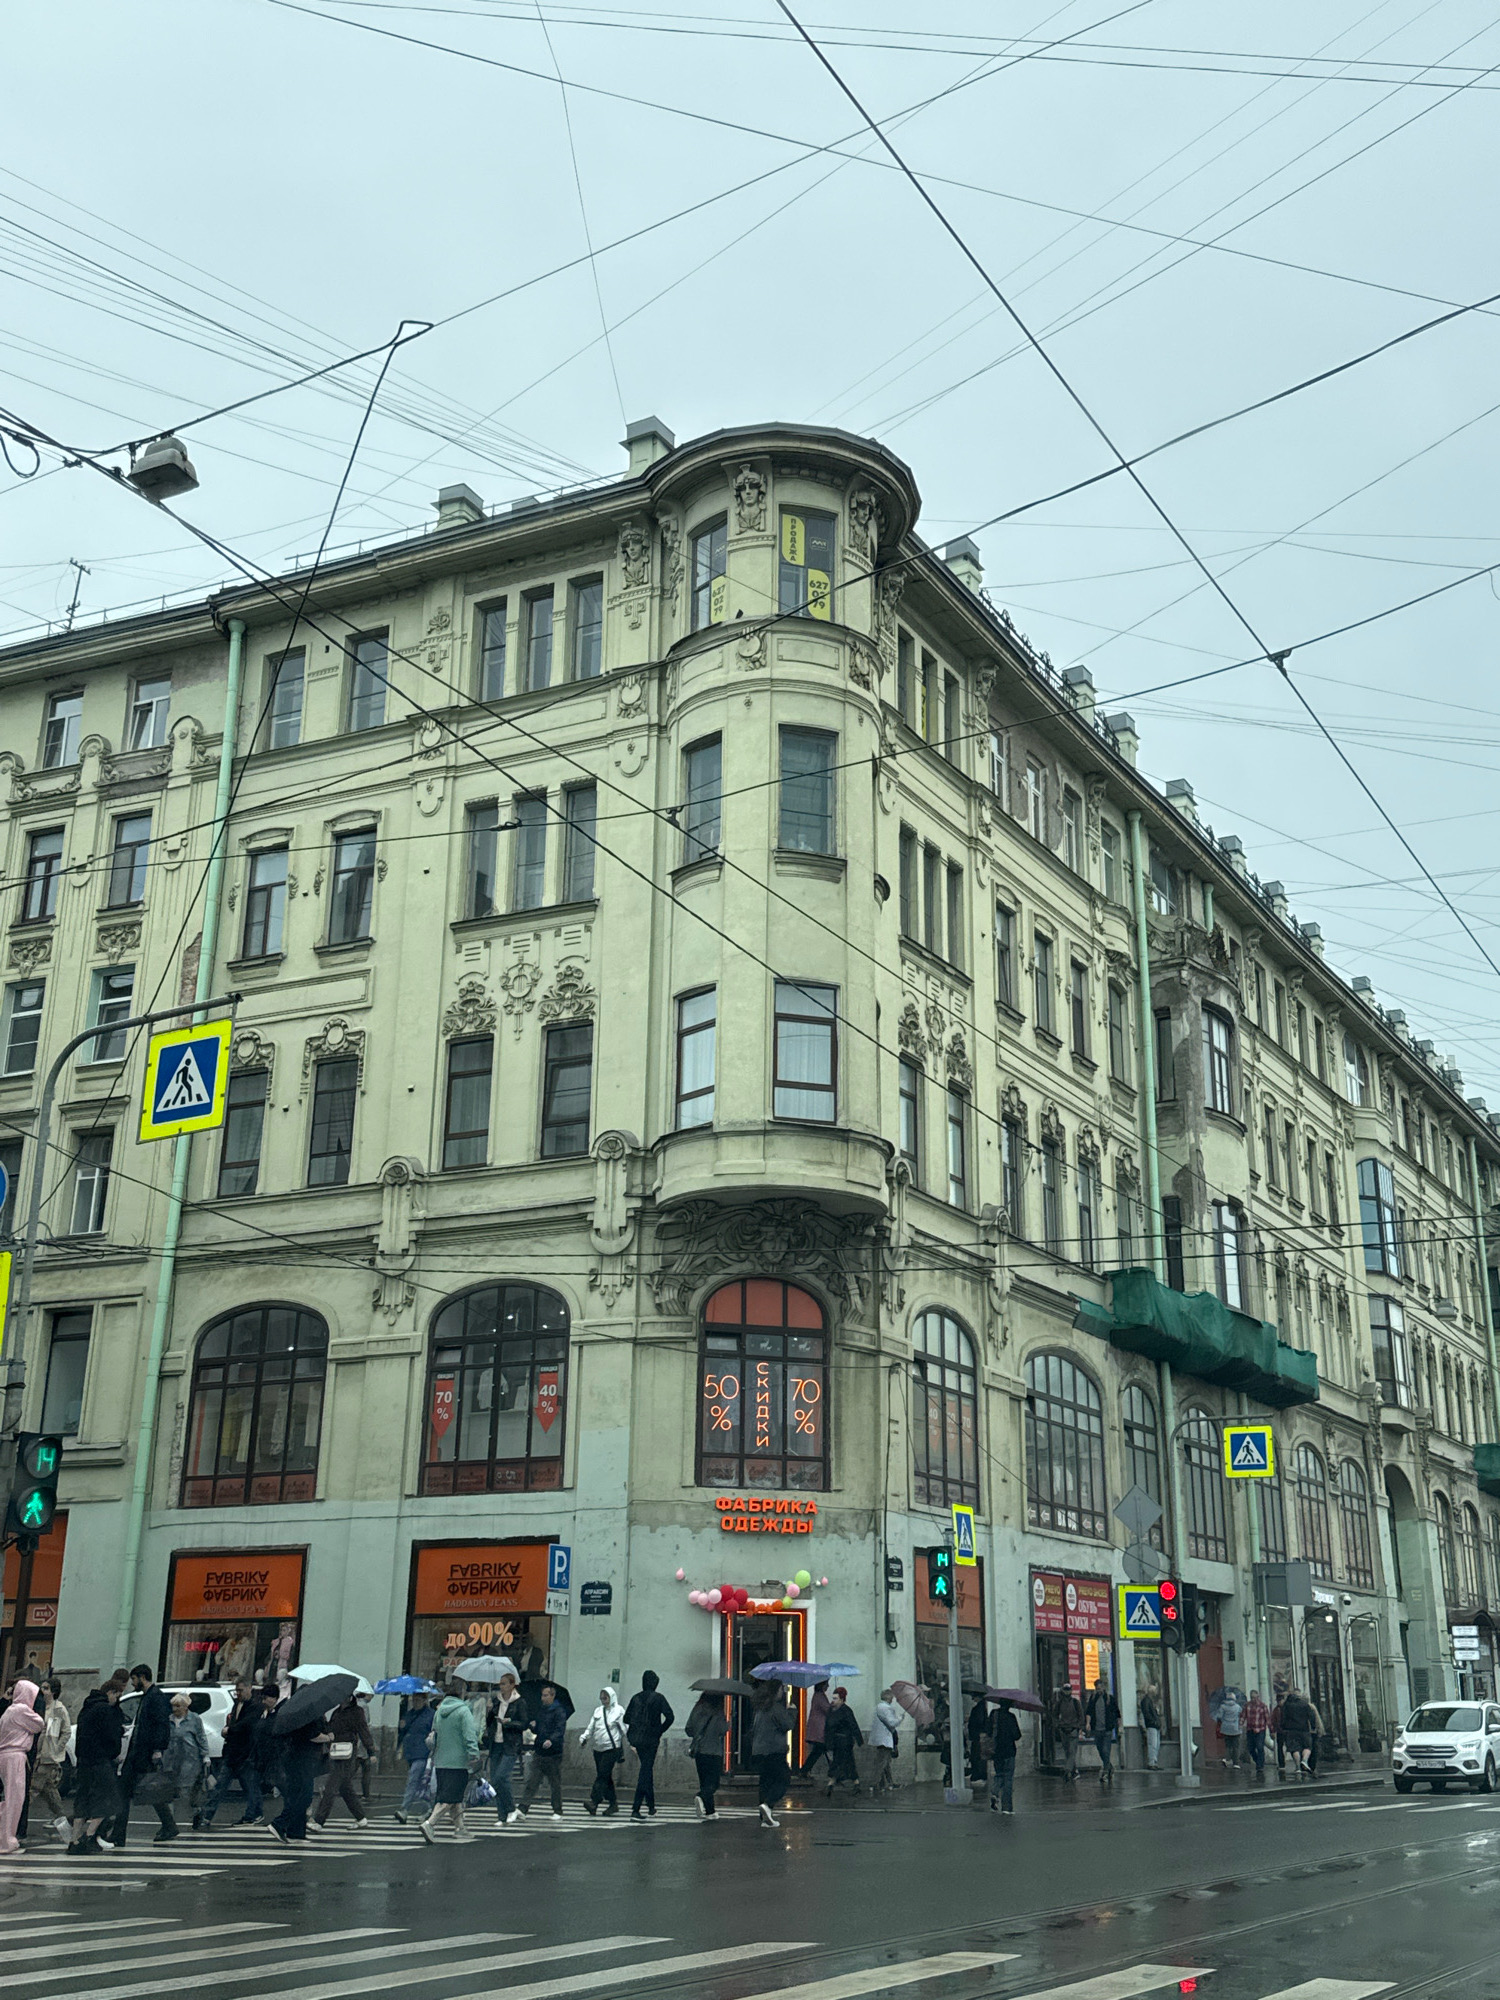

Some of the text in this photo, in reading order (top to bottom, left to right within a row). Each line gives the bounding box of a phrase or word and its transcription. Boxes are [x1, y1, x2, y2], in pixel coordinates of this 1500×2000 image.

[789, 518, 798, 562] ПРОДАЖА
[712, 584, 726, 598] 627
[809, 580, 829, 591] 627
[713, 595, 724, 606] 02
[811, 590, 827, 600] 02
[714, 605, 723, 616] 79
[812, 600, 826, 610] 79
[539, 1384, 557, 1397] 40
[703, 1374, 740, 1400] 50
[789, 1378, 821, 1404] 70
[436, 1391, 453, 1404] 70
[756, 1362, 770, 1447] СКИДКИ
[436, 1407, 449, 1420] %
[541, 1401, 554, 1414] %
[710, 1405, 732, 1431] %
[794, 1408, 816, 1434] %
[37, 1447, 56, 1472] 14
[716, 1497, 818, 1515] ФАБРИКА
[721, 1516, 814, 1534] ОДЕЖДЫ
[553, 1550, 567, 1585] P
[937, 1553, 949, 1567] 14
[206, 1570, 269, 1585] FABRIKA
[450, 1562, 521, 1578] FABRIKA
[203, 1587, 268, 1602] ФАБРИКА
[447, 1580, 520, 1596] ФАБРИКА
[489, 1597, 518, 1607] JEANS
[1078, 1599, 1097, 1614] ОБУВЬ
[1067, 1615, 1089, 1630] СУМКИ
[445, 1621, 514, 1649] до 90%
